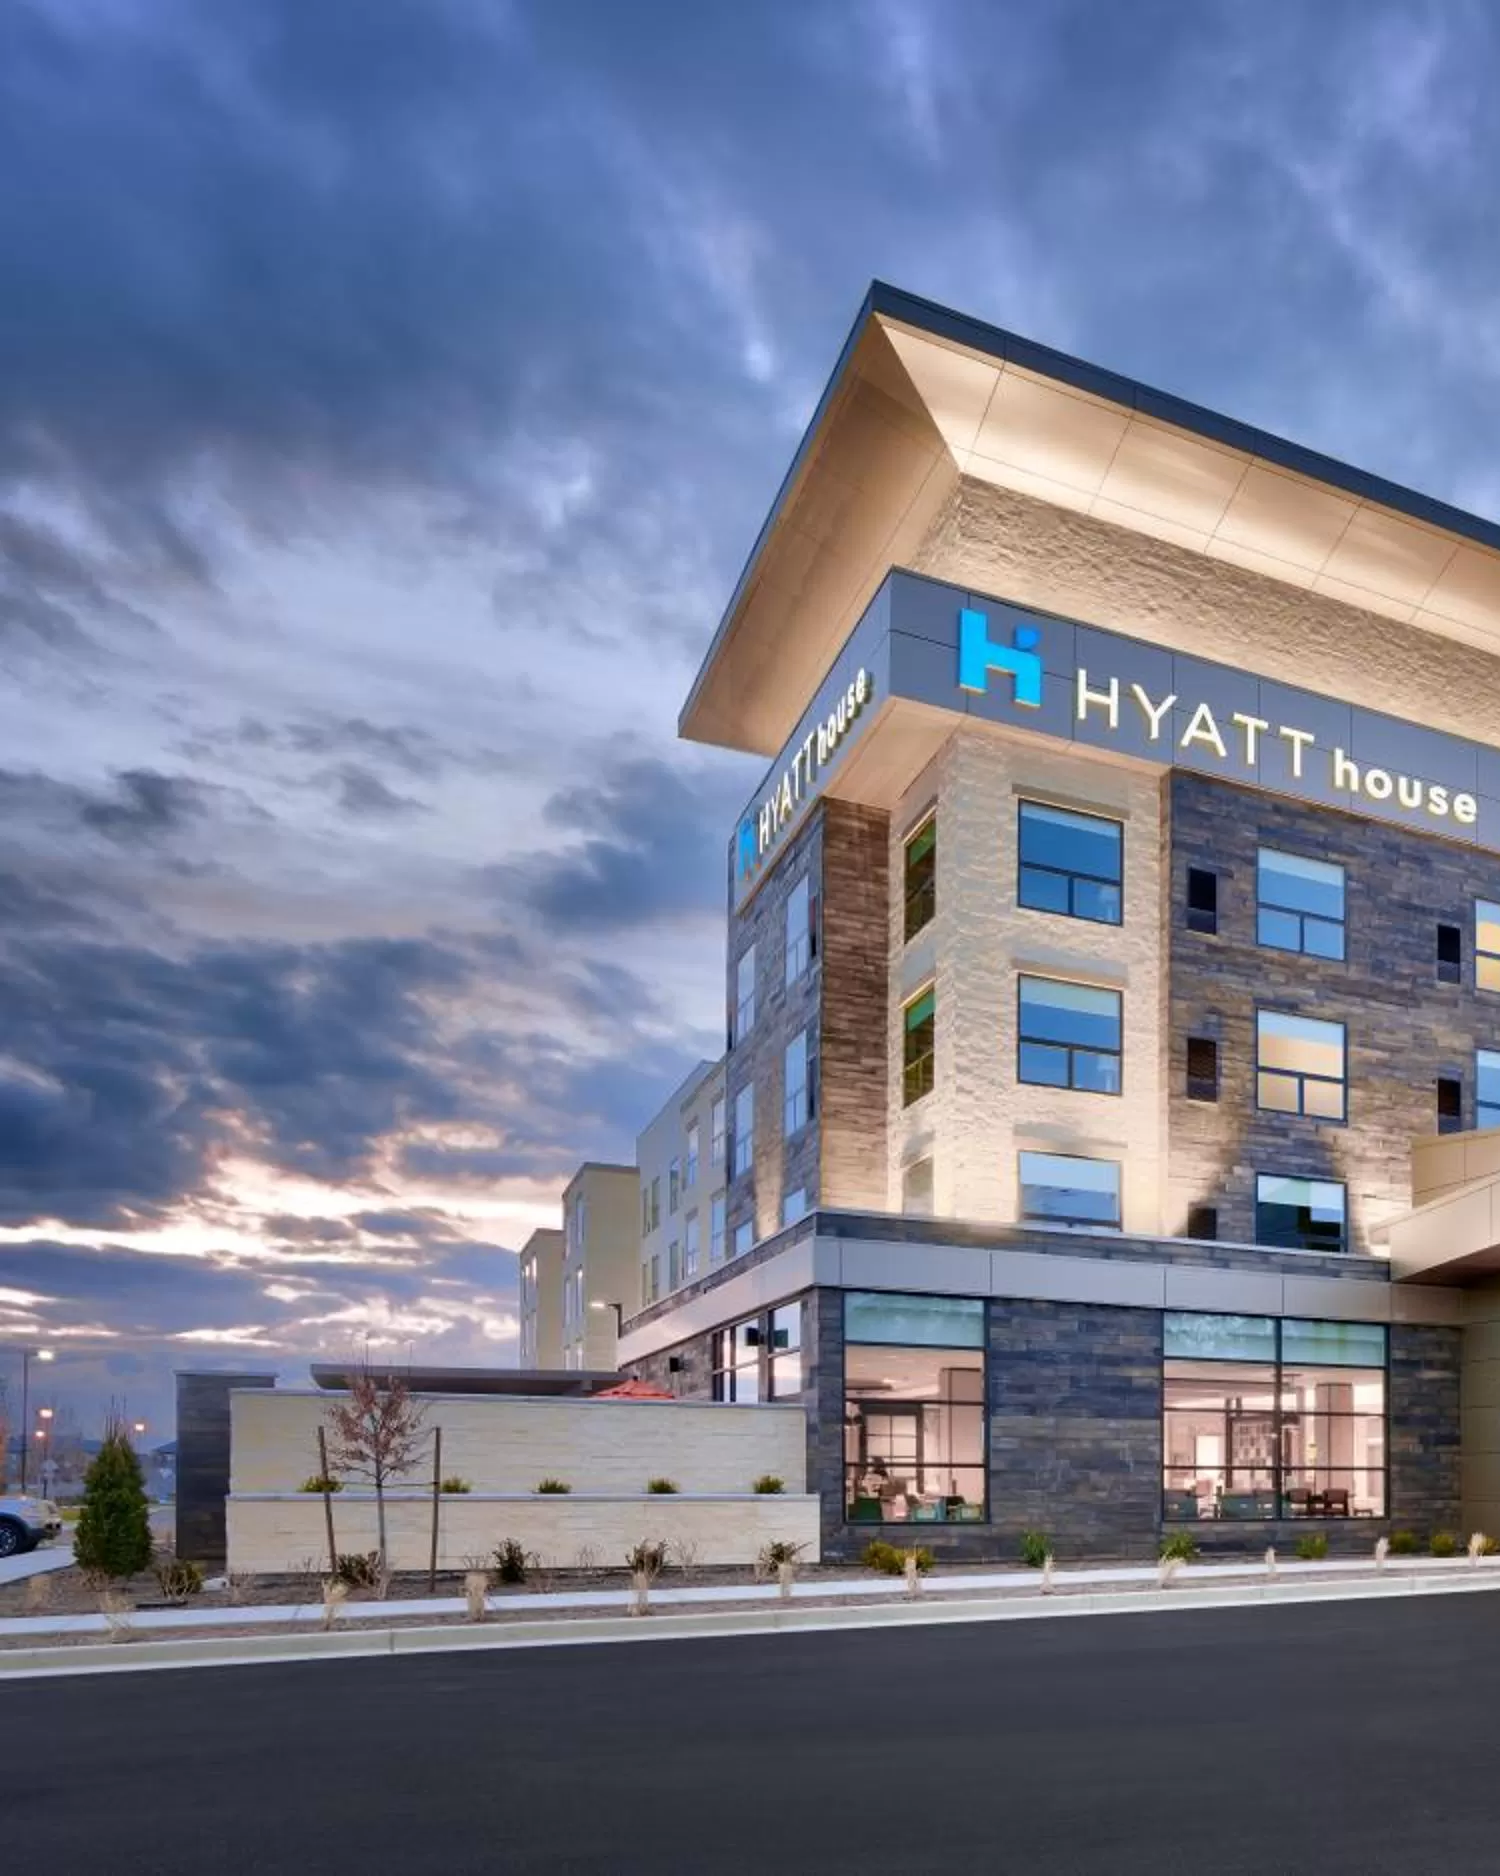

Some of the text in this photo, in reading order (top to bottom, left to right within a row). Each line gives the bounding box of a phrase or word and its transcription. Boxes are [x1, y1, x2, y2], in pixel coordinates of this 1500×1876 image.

[758, 667, 867, 854] HYATT house
[1076, 667, 1315, 778] HYATT
[1333, 747, 1477, 823] house
